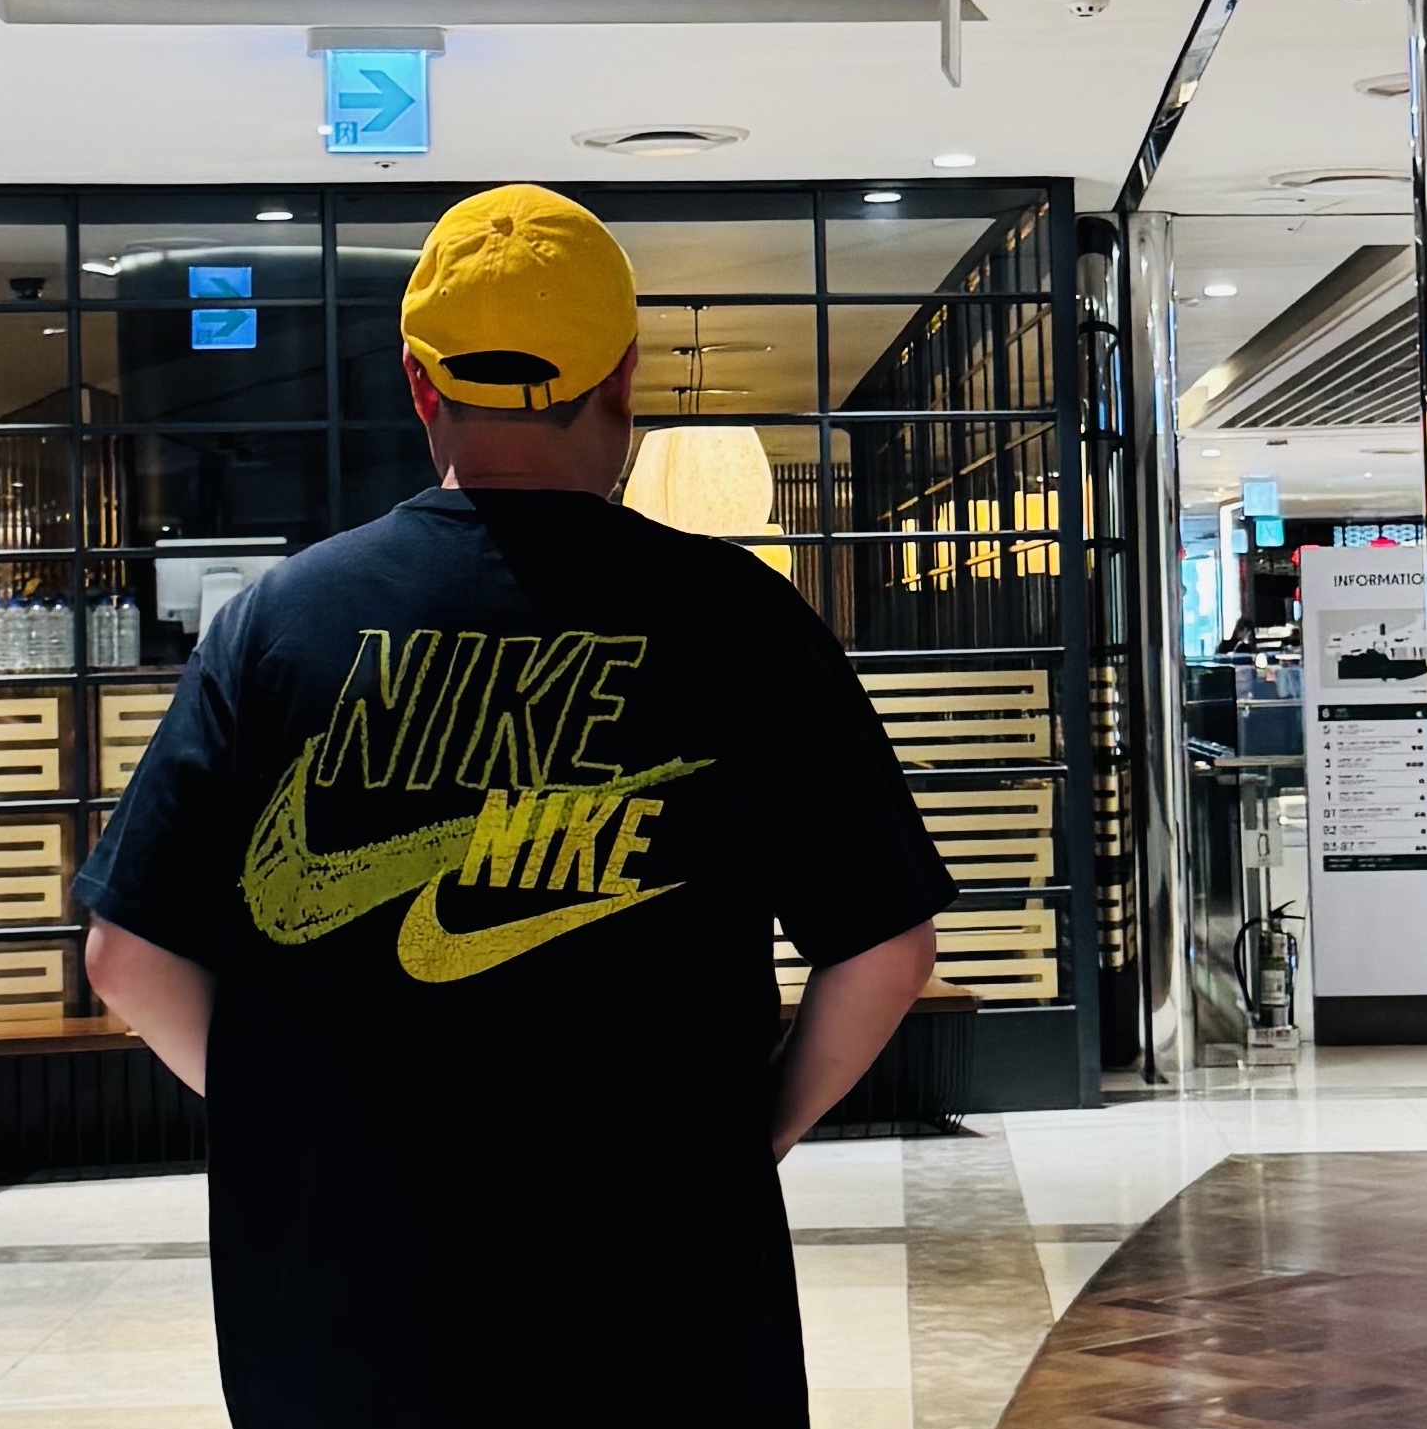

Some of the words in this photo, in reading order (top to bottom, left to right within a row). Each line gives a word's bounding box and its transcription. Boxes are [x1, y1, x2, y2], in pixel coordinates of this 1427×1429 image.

[1334, 573, 1424, 587] INFORMATIO
[316, 629, 647, 790] NIKE
[1325, 775, 1332, 785] 2
[459, 789, 664, 893] NIKE
